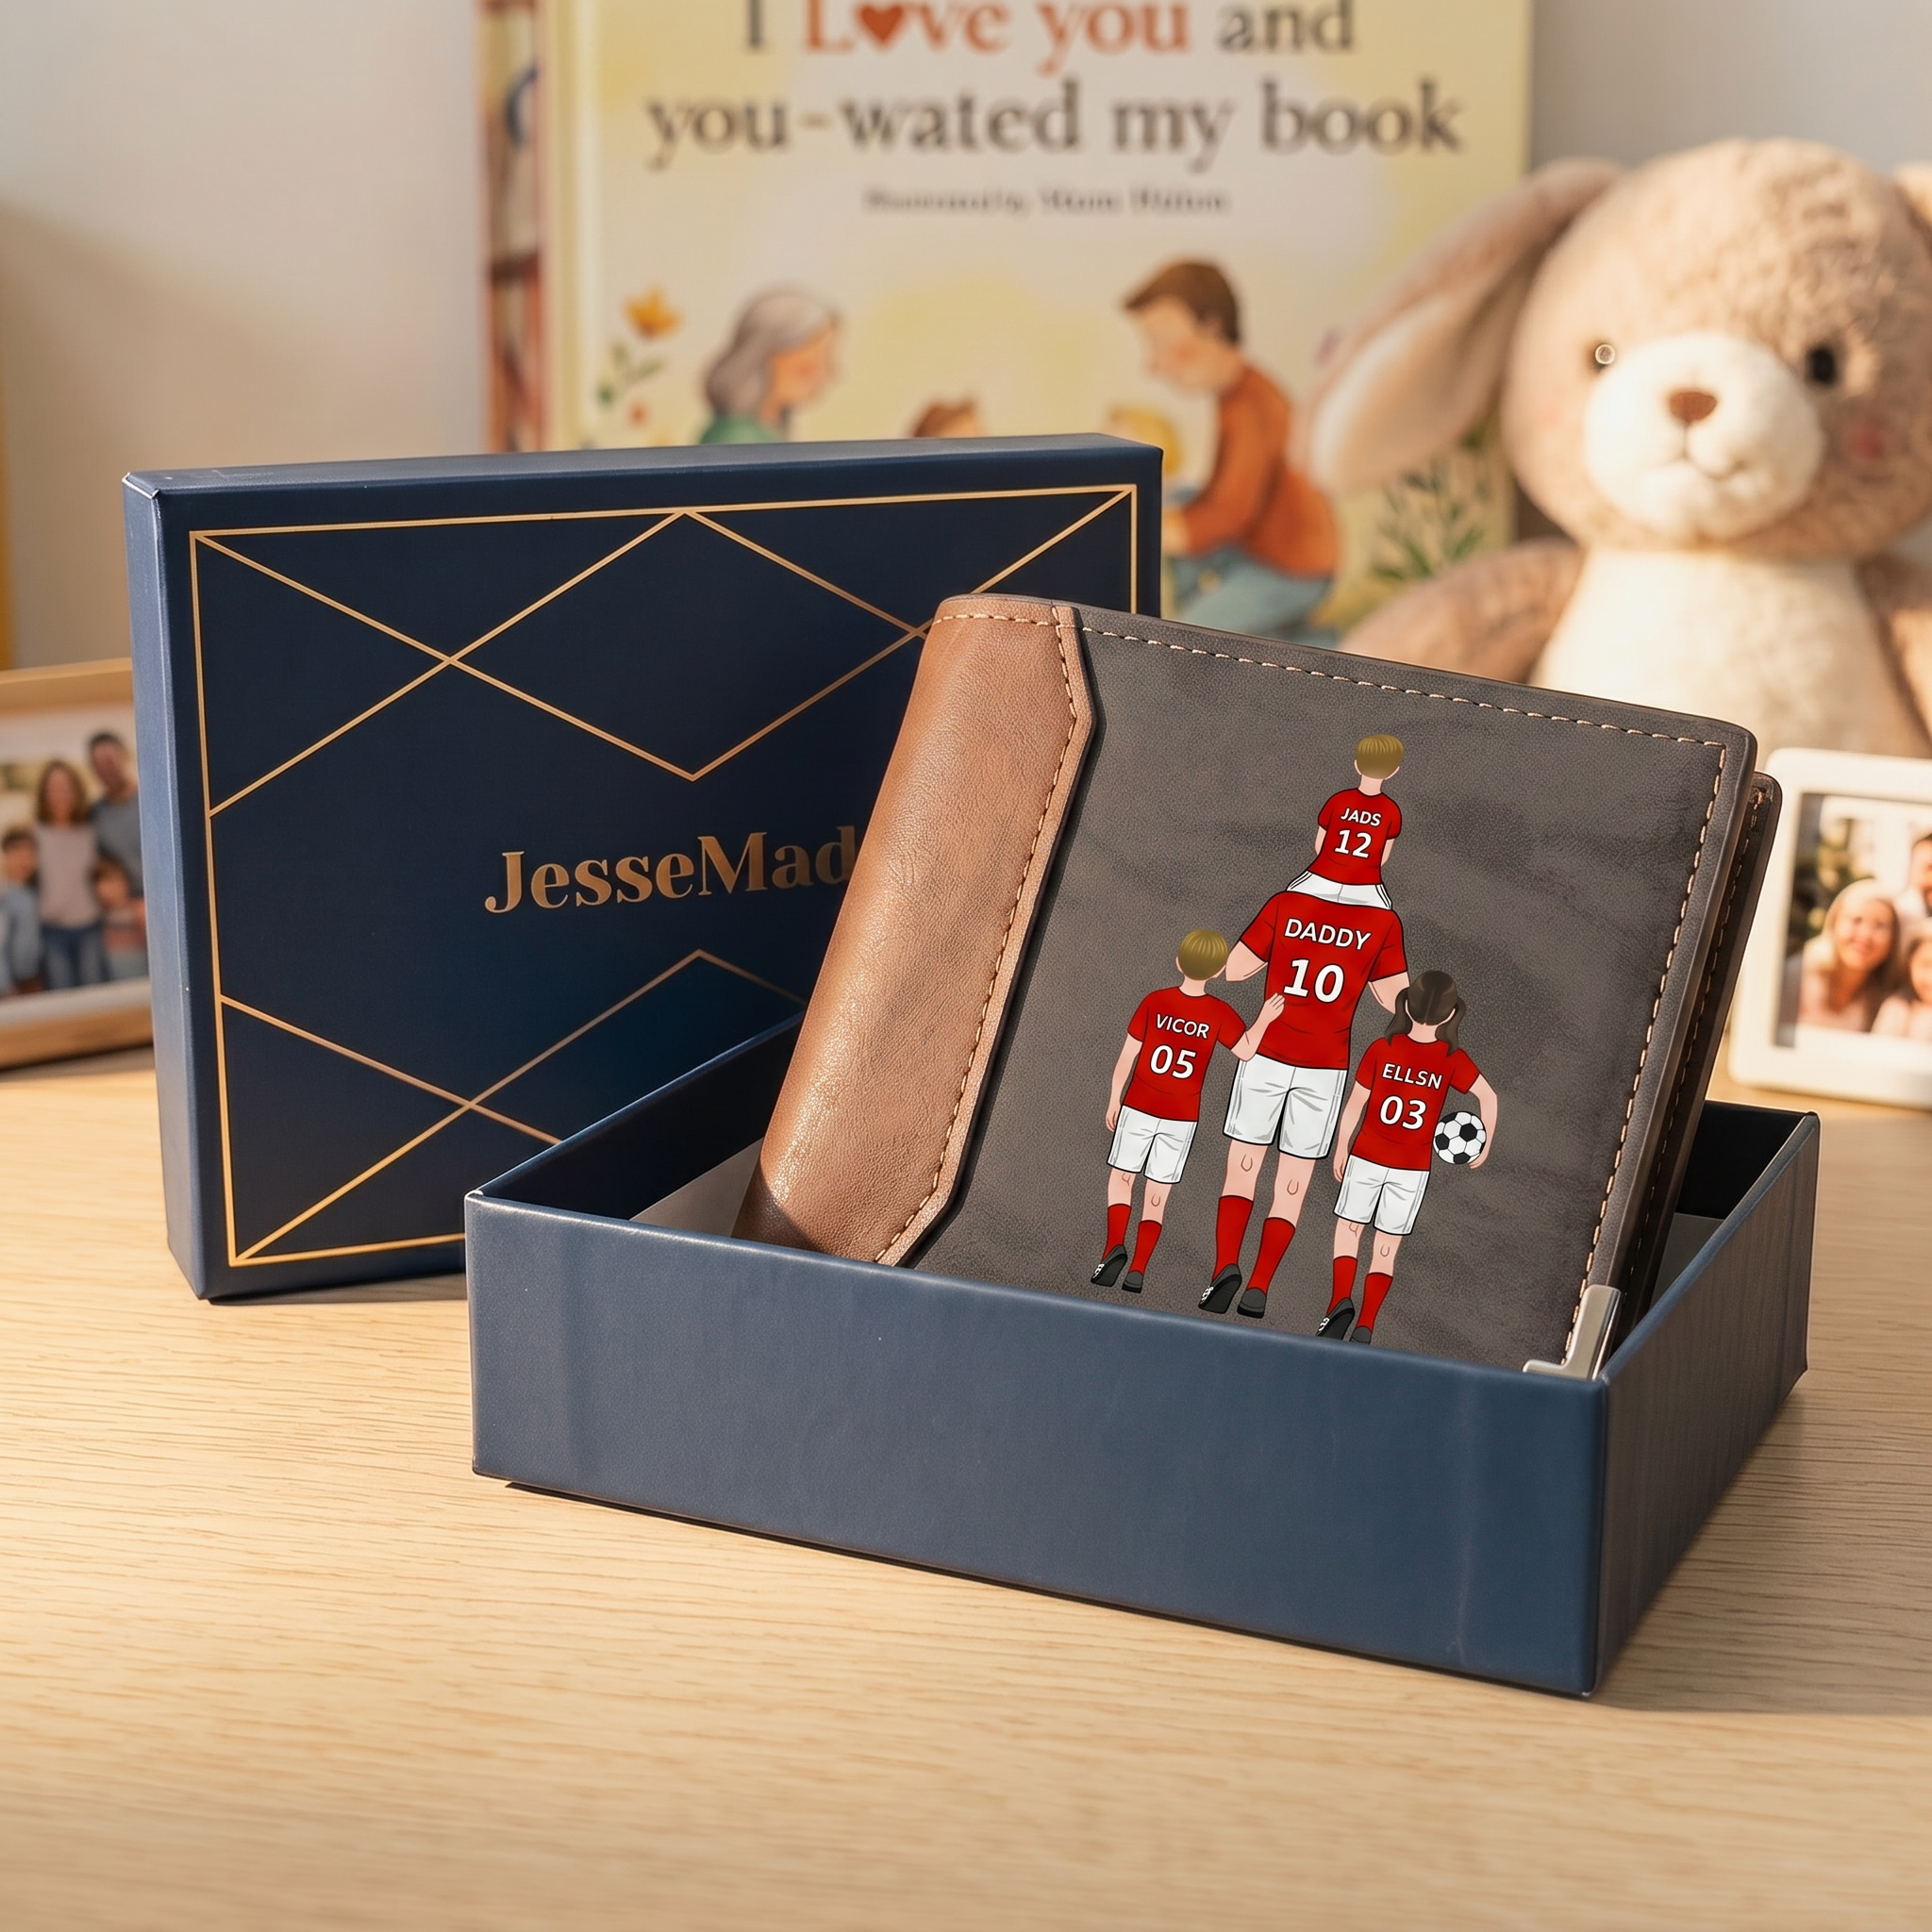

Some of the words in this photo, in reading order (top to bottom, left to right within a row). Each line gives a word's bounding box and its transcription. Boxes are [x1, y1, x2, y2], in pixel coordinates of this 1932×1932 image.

[1036, 0, 1191, 76] you
[1218, 0, 1357, 53] and
[1111, 98, 1236, 175] my
[1260, 76, 1466, 154] book
[1340, 808, 1381, 826] JADS
[1334, 829, 1372, 858] 12
[1283, 918, 1372, 951] DADDY
[1283, 958, 1344, 1003] 10
[1155, 1013, 1210, 1039] VICOR
[1149, 1044, 1197, 1079] 05
[1381, 1063, 1442, 1090] ELLSN
[1379, 1095, 1427, 1130] 03
